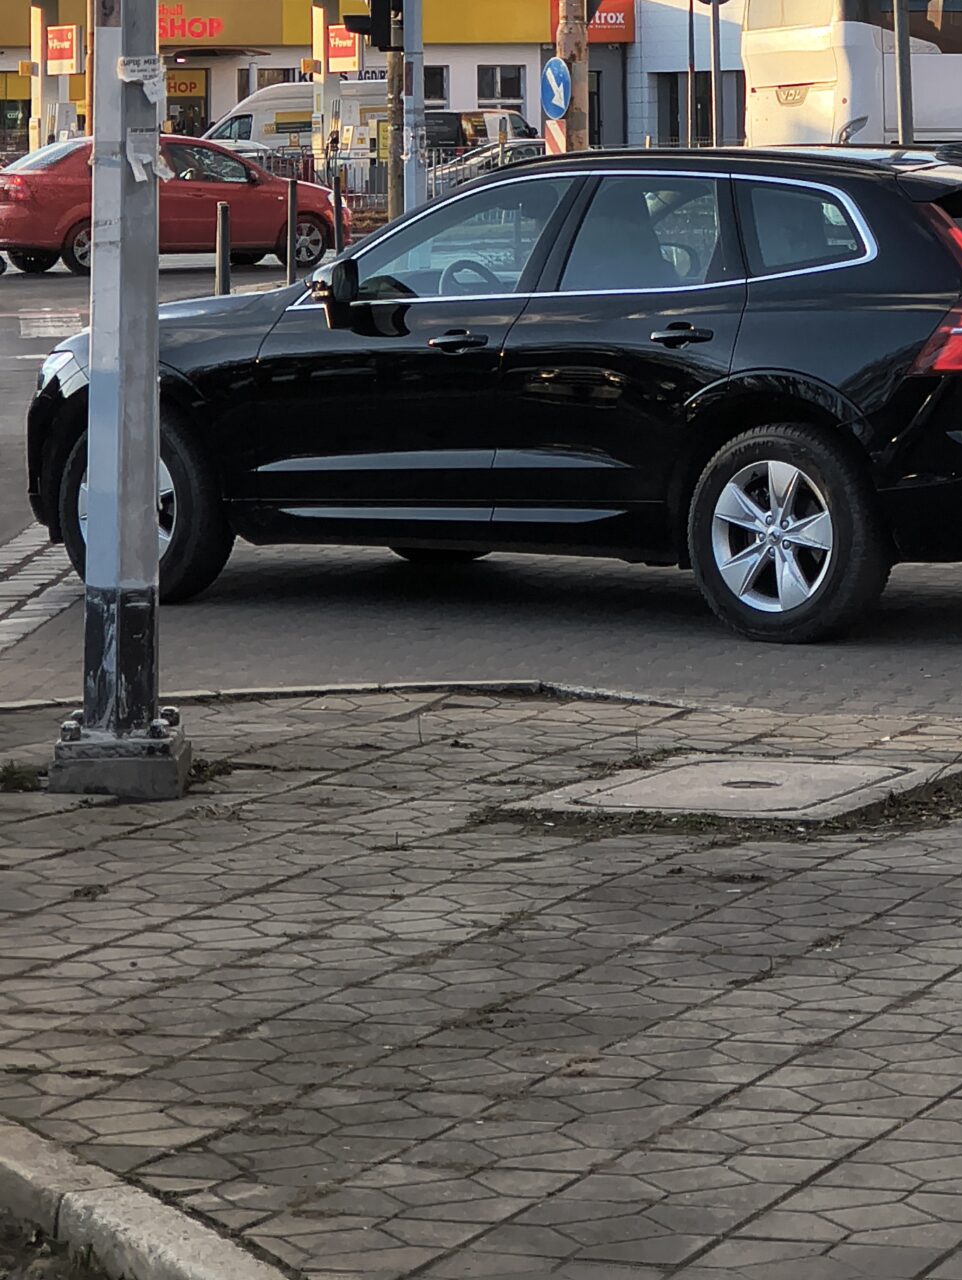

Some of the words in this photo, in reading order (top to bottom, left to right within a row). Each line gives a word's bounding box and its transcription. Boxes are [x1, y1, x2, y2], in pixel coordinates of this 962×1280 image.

[591, 11, 625, 24] trox
[158, 18, 224, 38] SHOP
[357, 70, 389, 81] AGD/R
[167, 81, 197, 93] HOP
